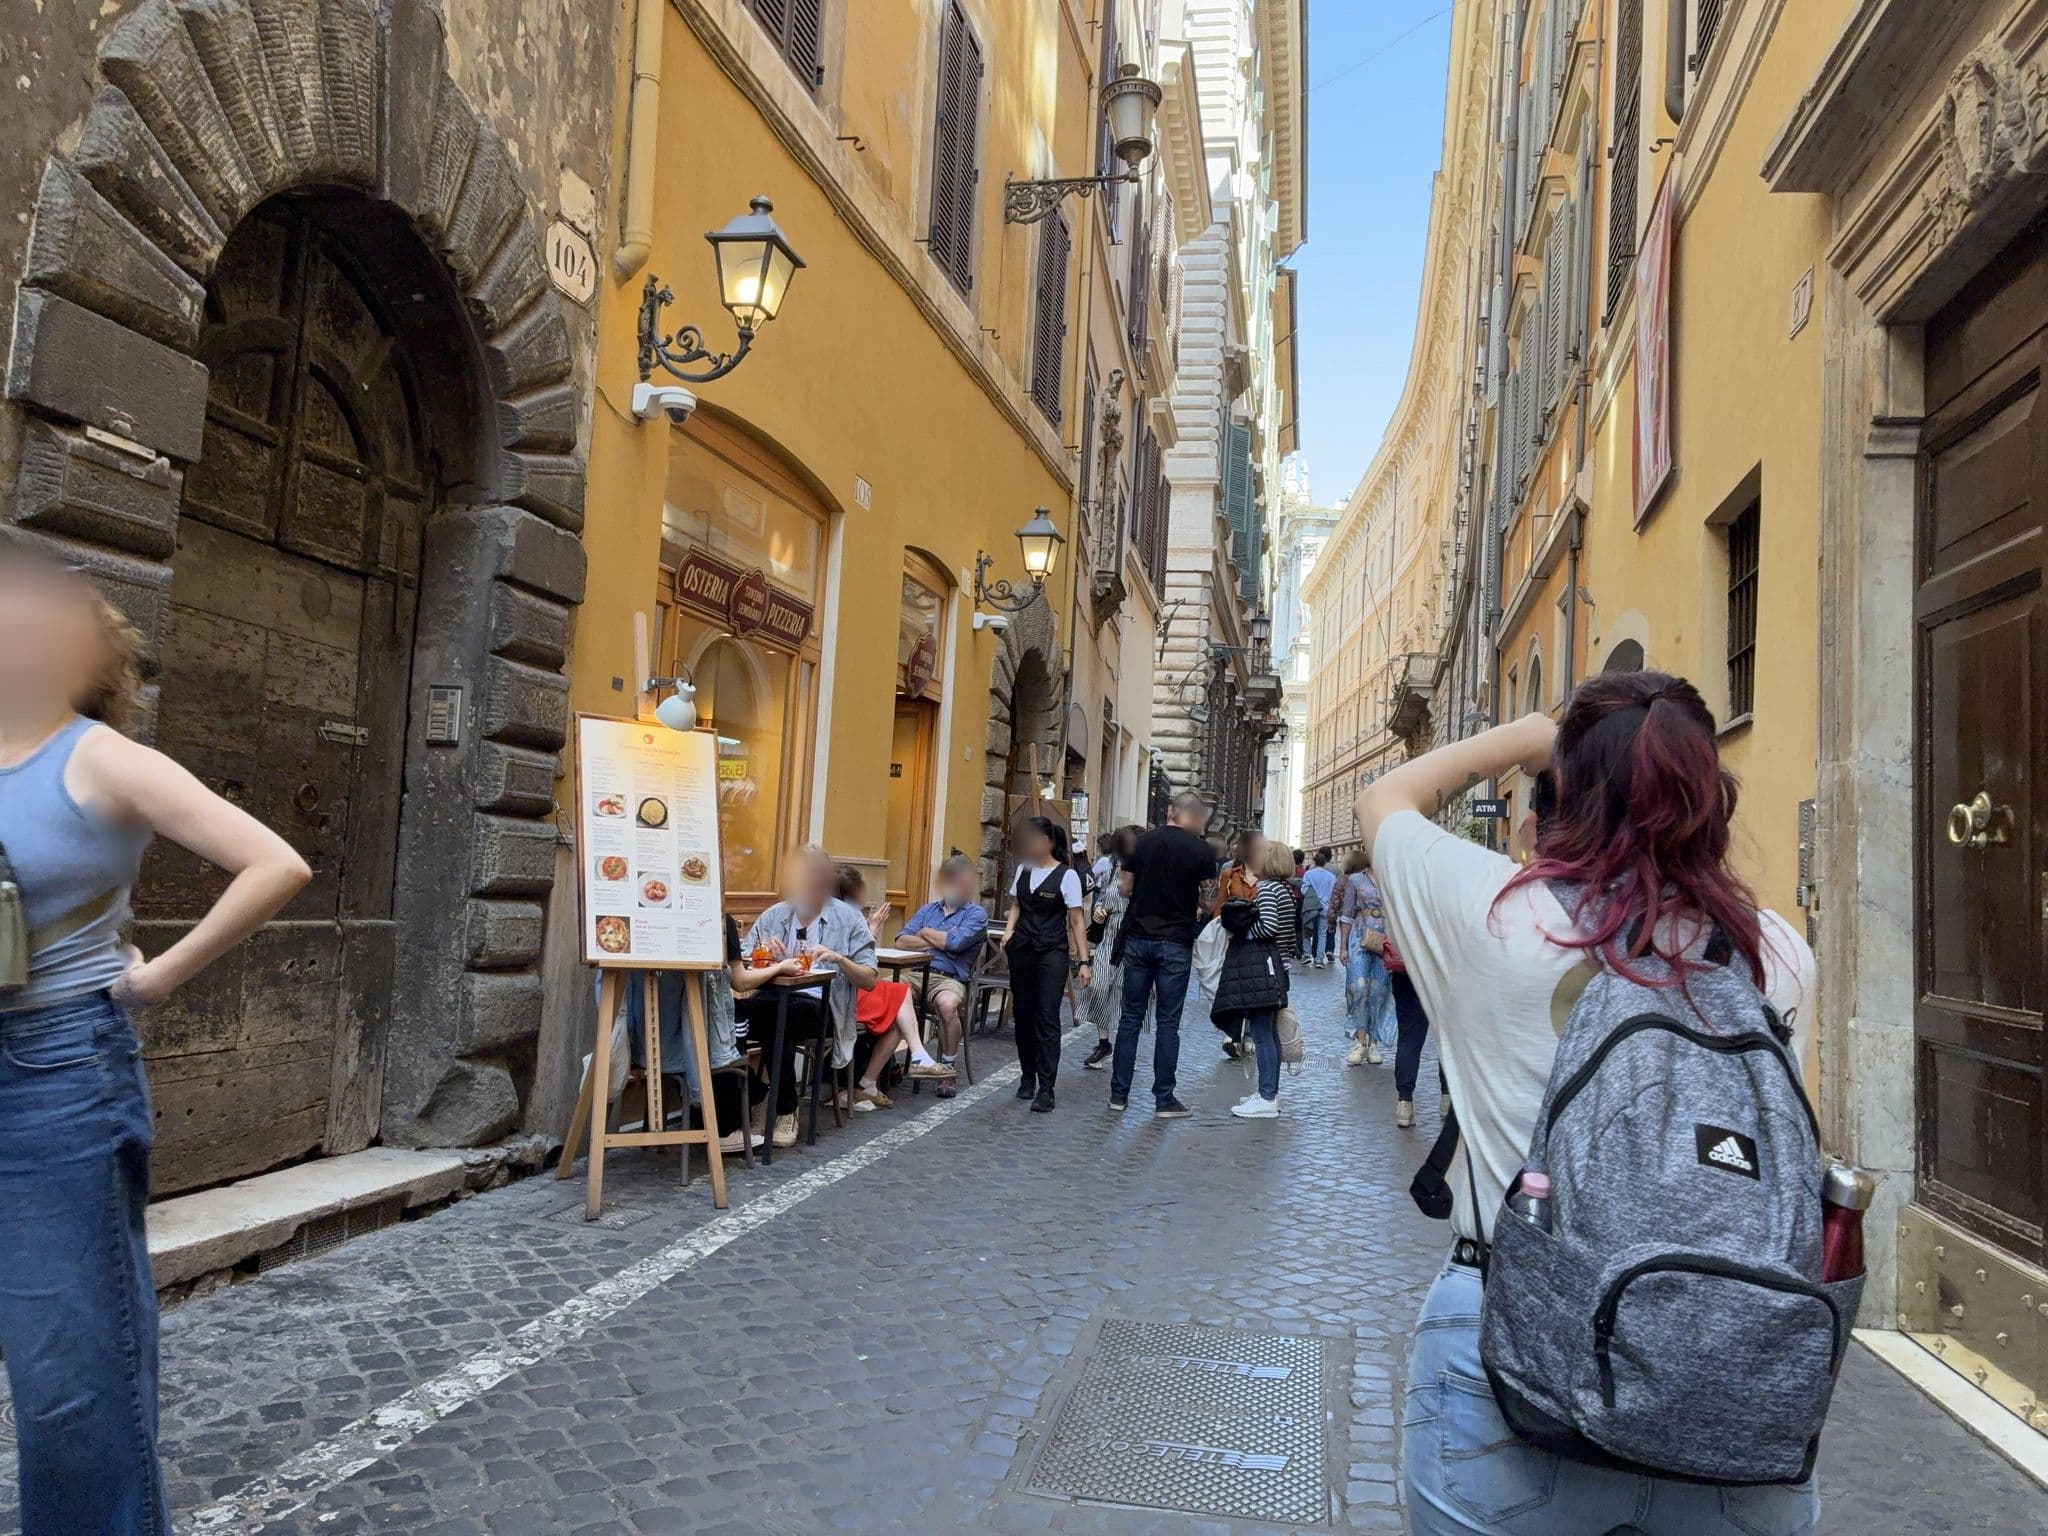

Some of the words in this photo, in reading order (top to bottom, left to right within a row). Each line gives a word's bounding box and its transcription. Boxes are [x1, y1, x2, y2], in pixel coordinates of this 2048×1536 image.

[554, 237, 586, 288] 104
[1793, 279, 1808, 324] 87
[684, 565, 729, 605] OSTERIA
[766, 603, 805, 638] PIZZERIA
[1475, 805, 1497, 813] ATM
[1118, 1354, 1236, 1374] TELECOM
[1086, 1437, 1219, 1463] TELECOM
